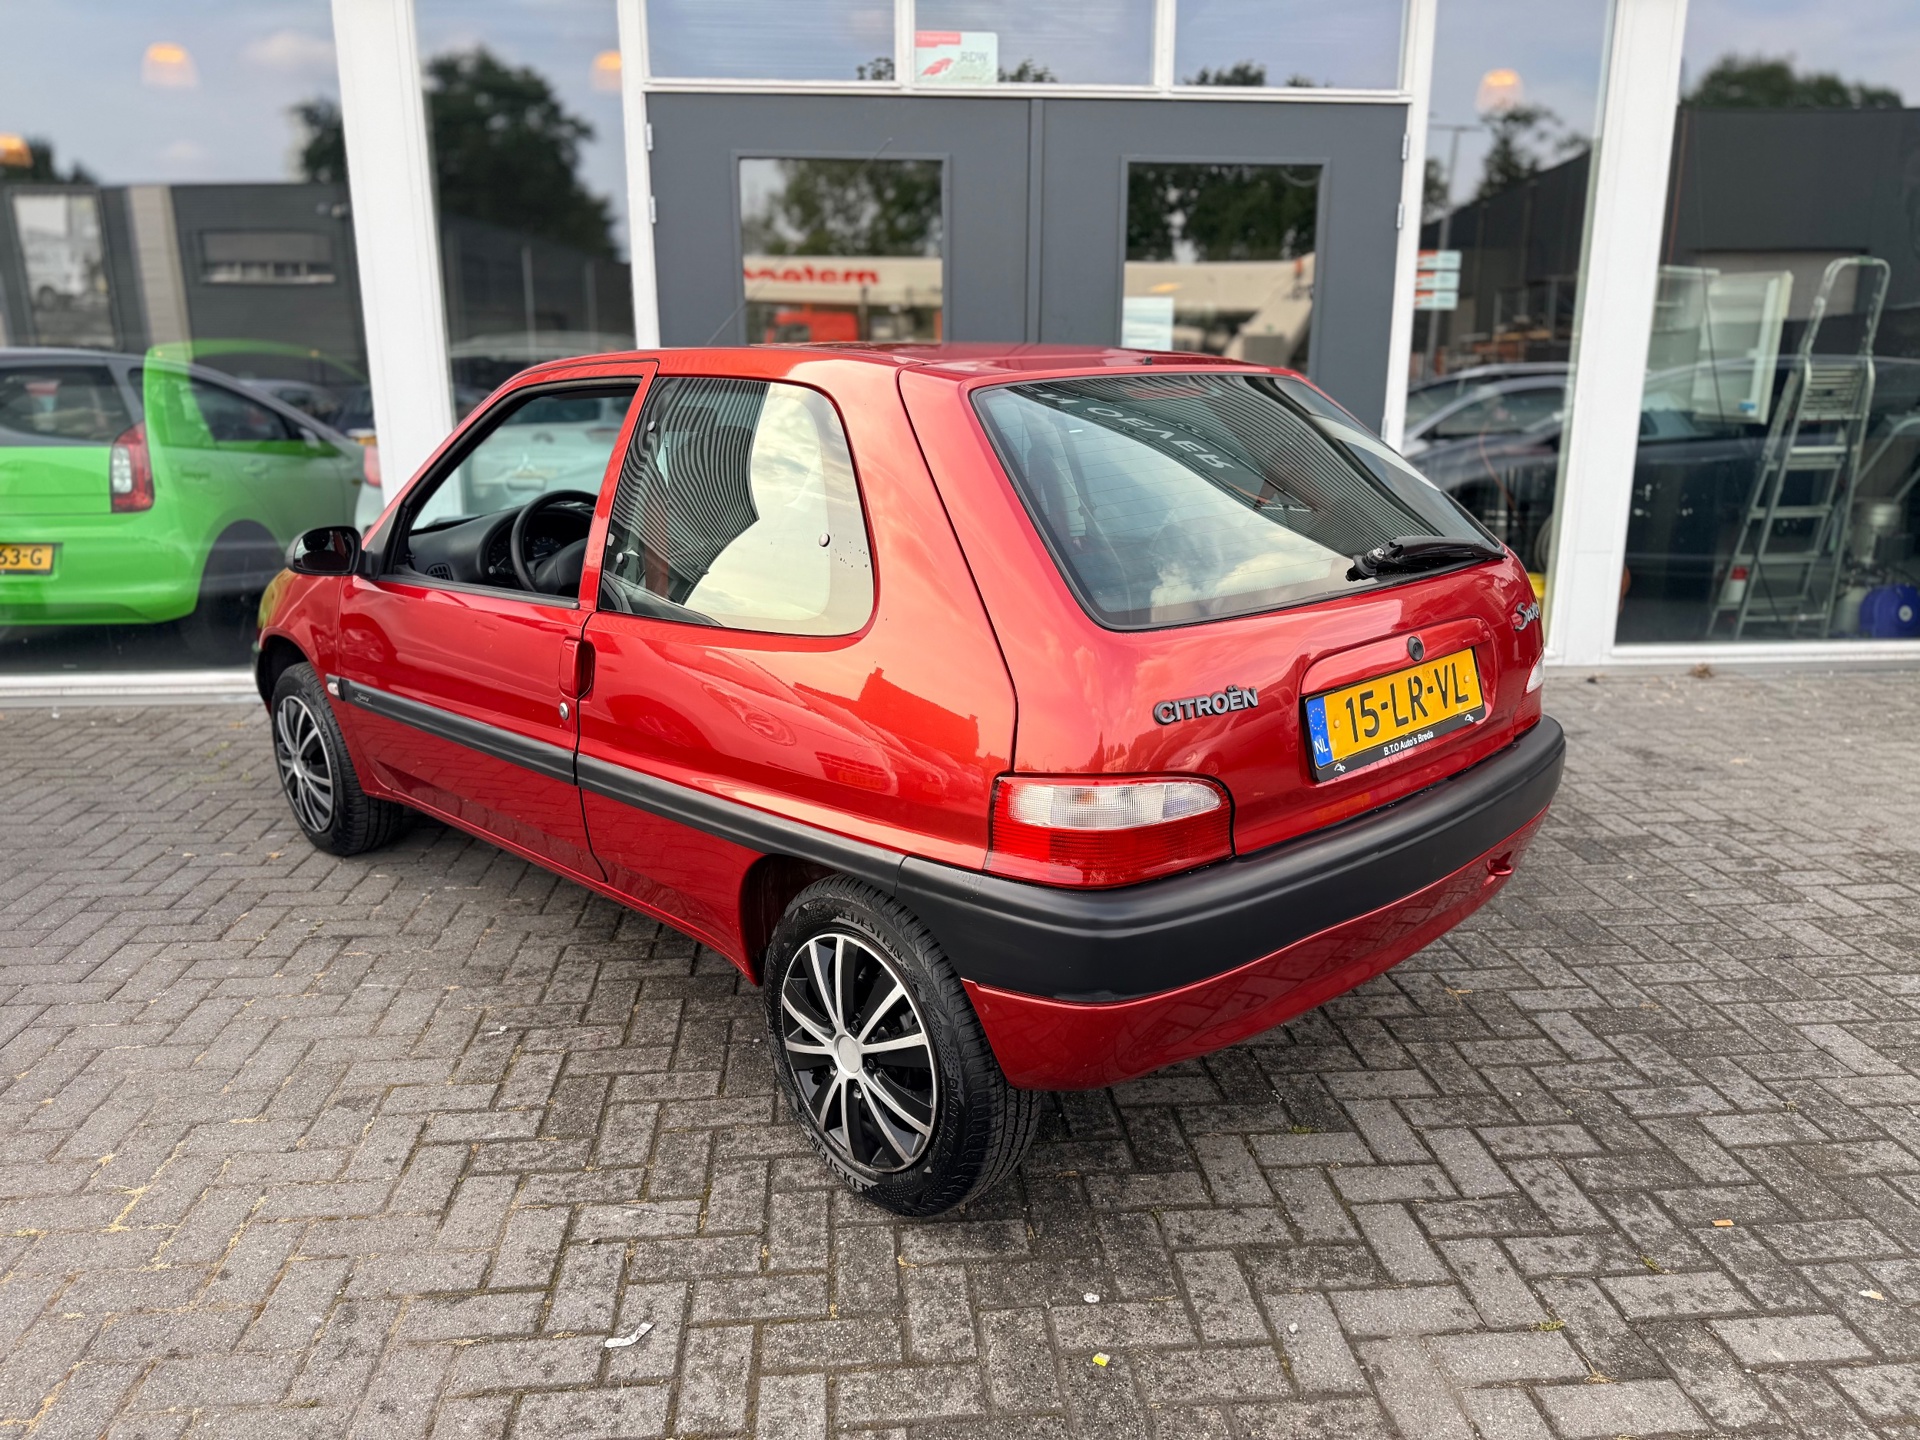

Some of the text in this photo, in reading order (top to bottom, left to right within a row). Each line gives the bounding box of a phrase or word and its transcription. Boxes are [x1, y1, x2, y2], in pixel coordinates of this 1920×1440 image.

[1153, 685, 1259, 725] CITROËN
[1345, 662, 1470, 743] 15-LR-VL
[1313, 740, 1329, 755] NL
[1383, 730, 1434, 756] B.T.O Auto's Breda
